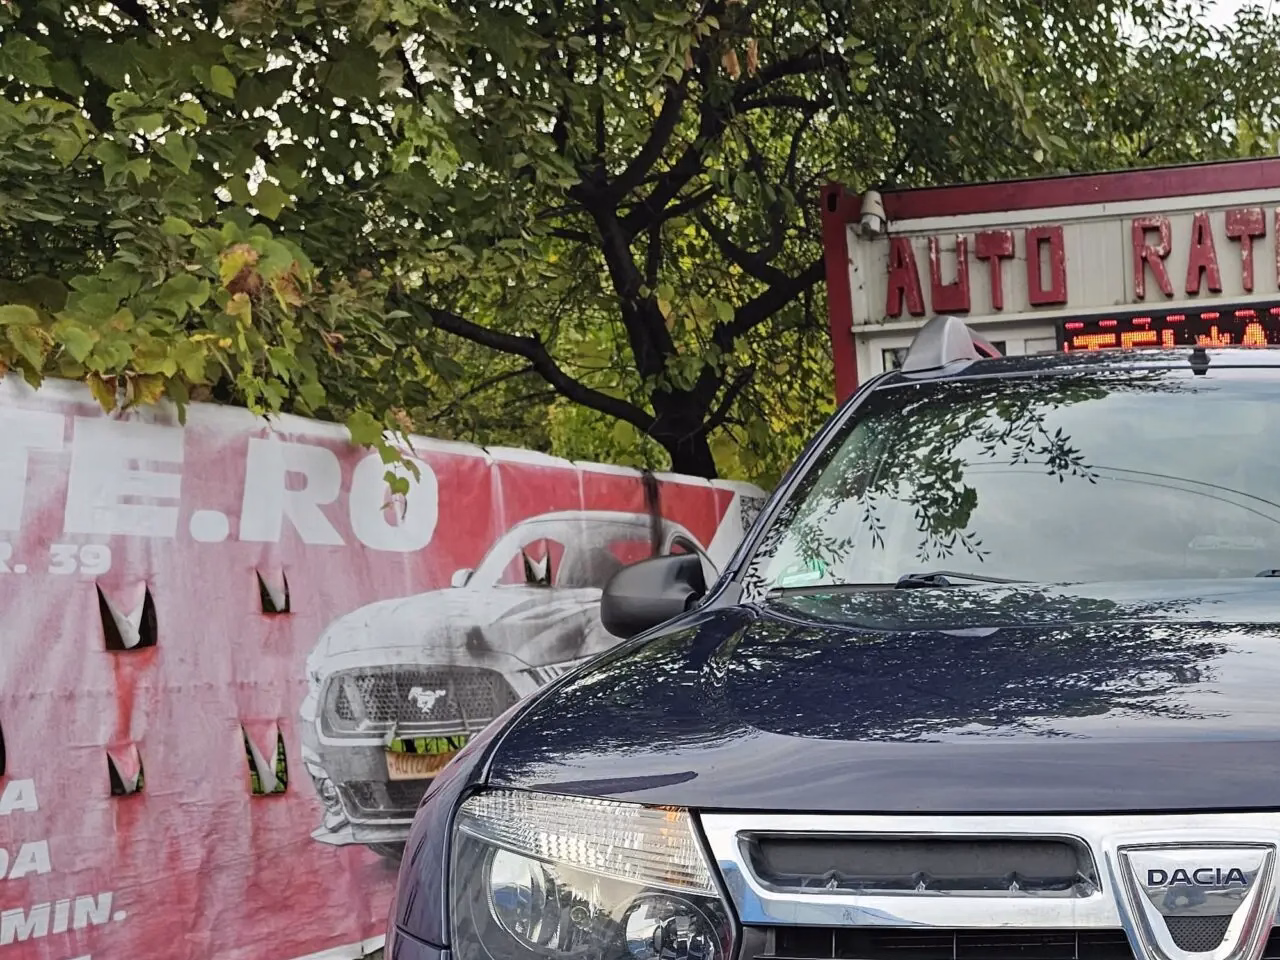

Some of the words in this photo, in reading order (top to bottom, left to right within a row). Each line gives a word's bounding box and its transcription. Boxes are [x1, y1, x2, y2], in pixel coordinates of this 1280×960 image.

[886, 225, 1068, 317] AUTO
[48, 544, 112, 575] 39
[1147, 867, 1248, 886] DACIA
[0, 891, 127, 945] MIN.
